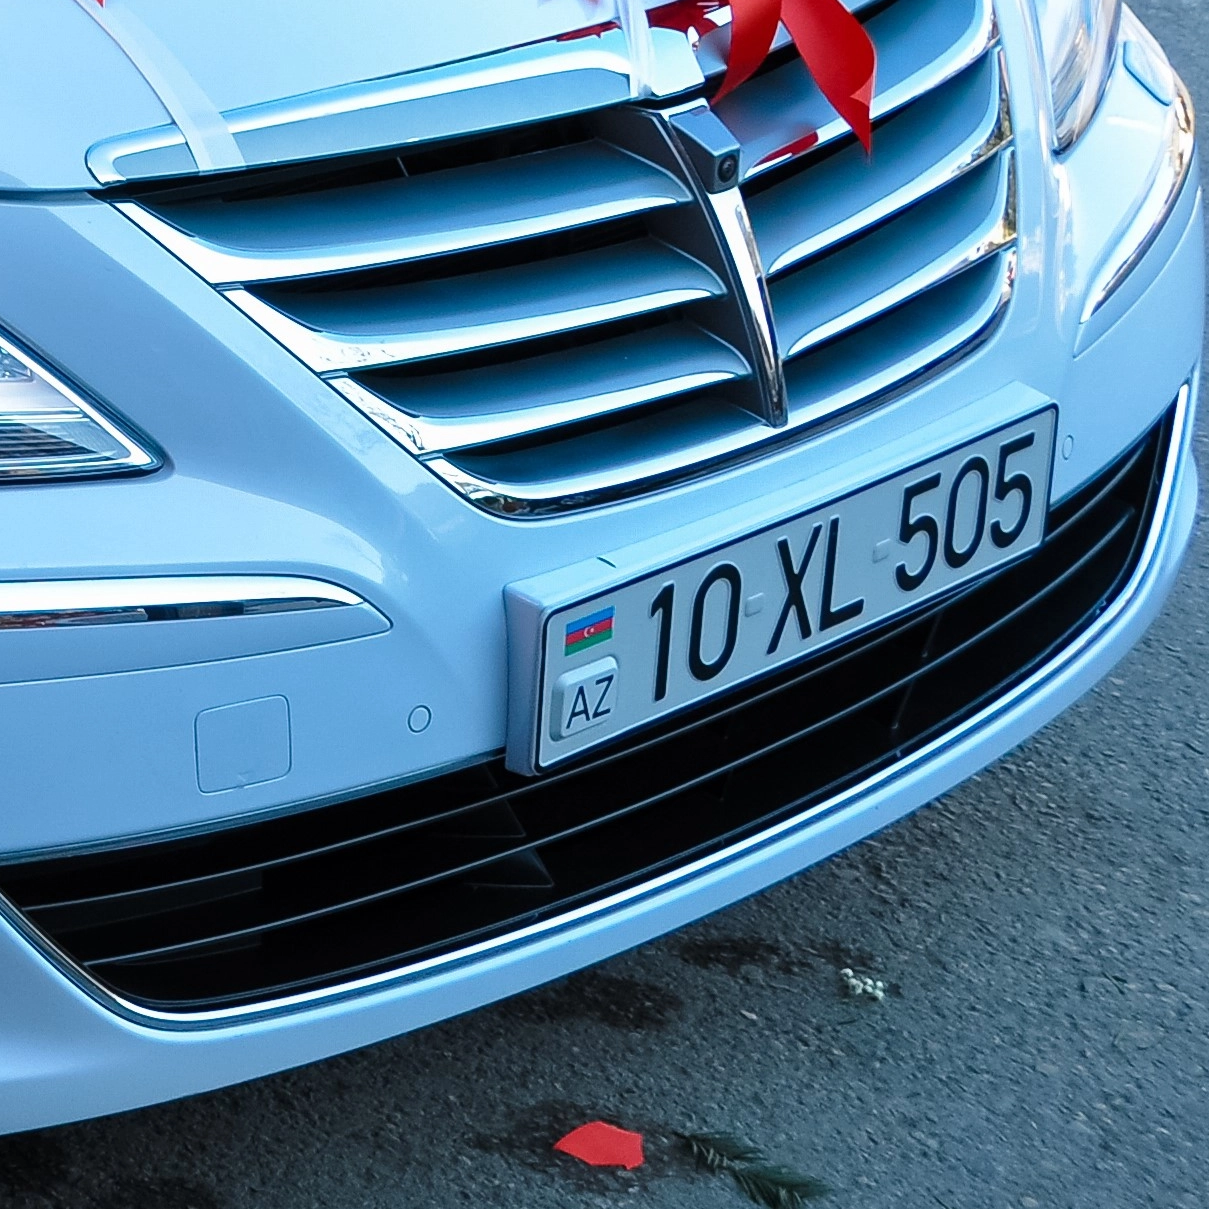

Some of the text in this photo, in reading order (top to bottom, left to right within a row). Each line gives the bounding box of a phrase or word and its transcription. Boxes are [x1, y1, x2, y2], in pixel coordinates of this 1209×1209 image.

[650, 432, 1035, 702] 10 XL 505
[565, 674, 614, 730] AZ
